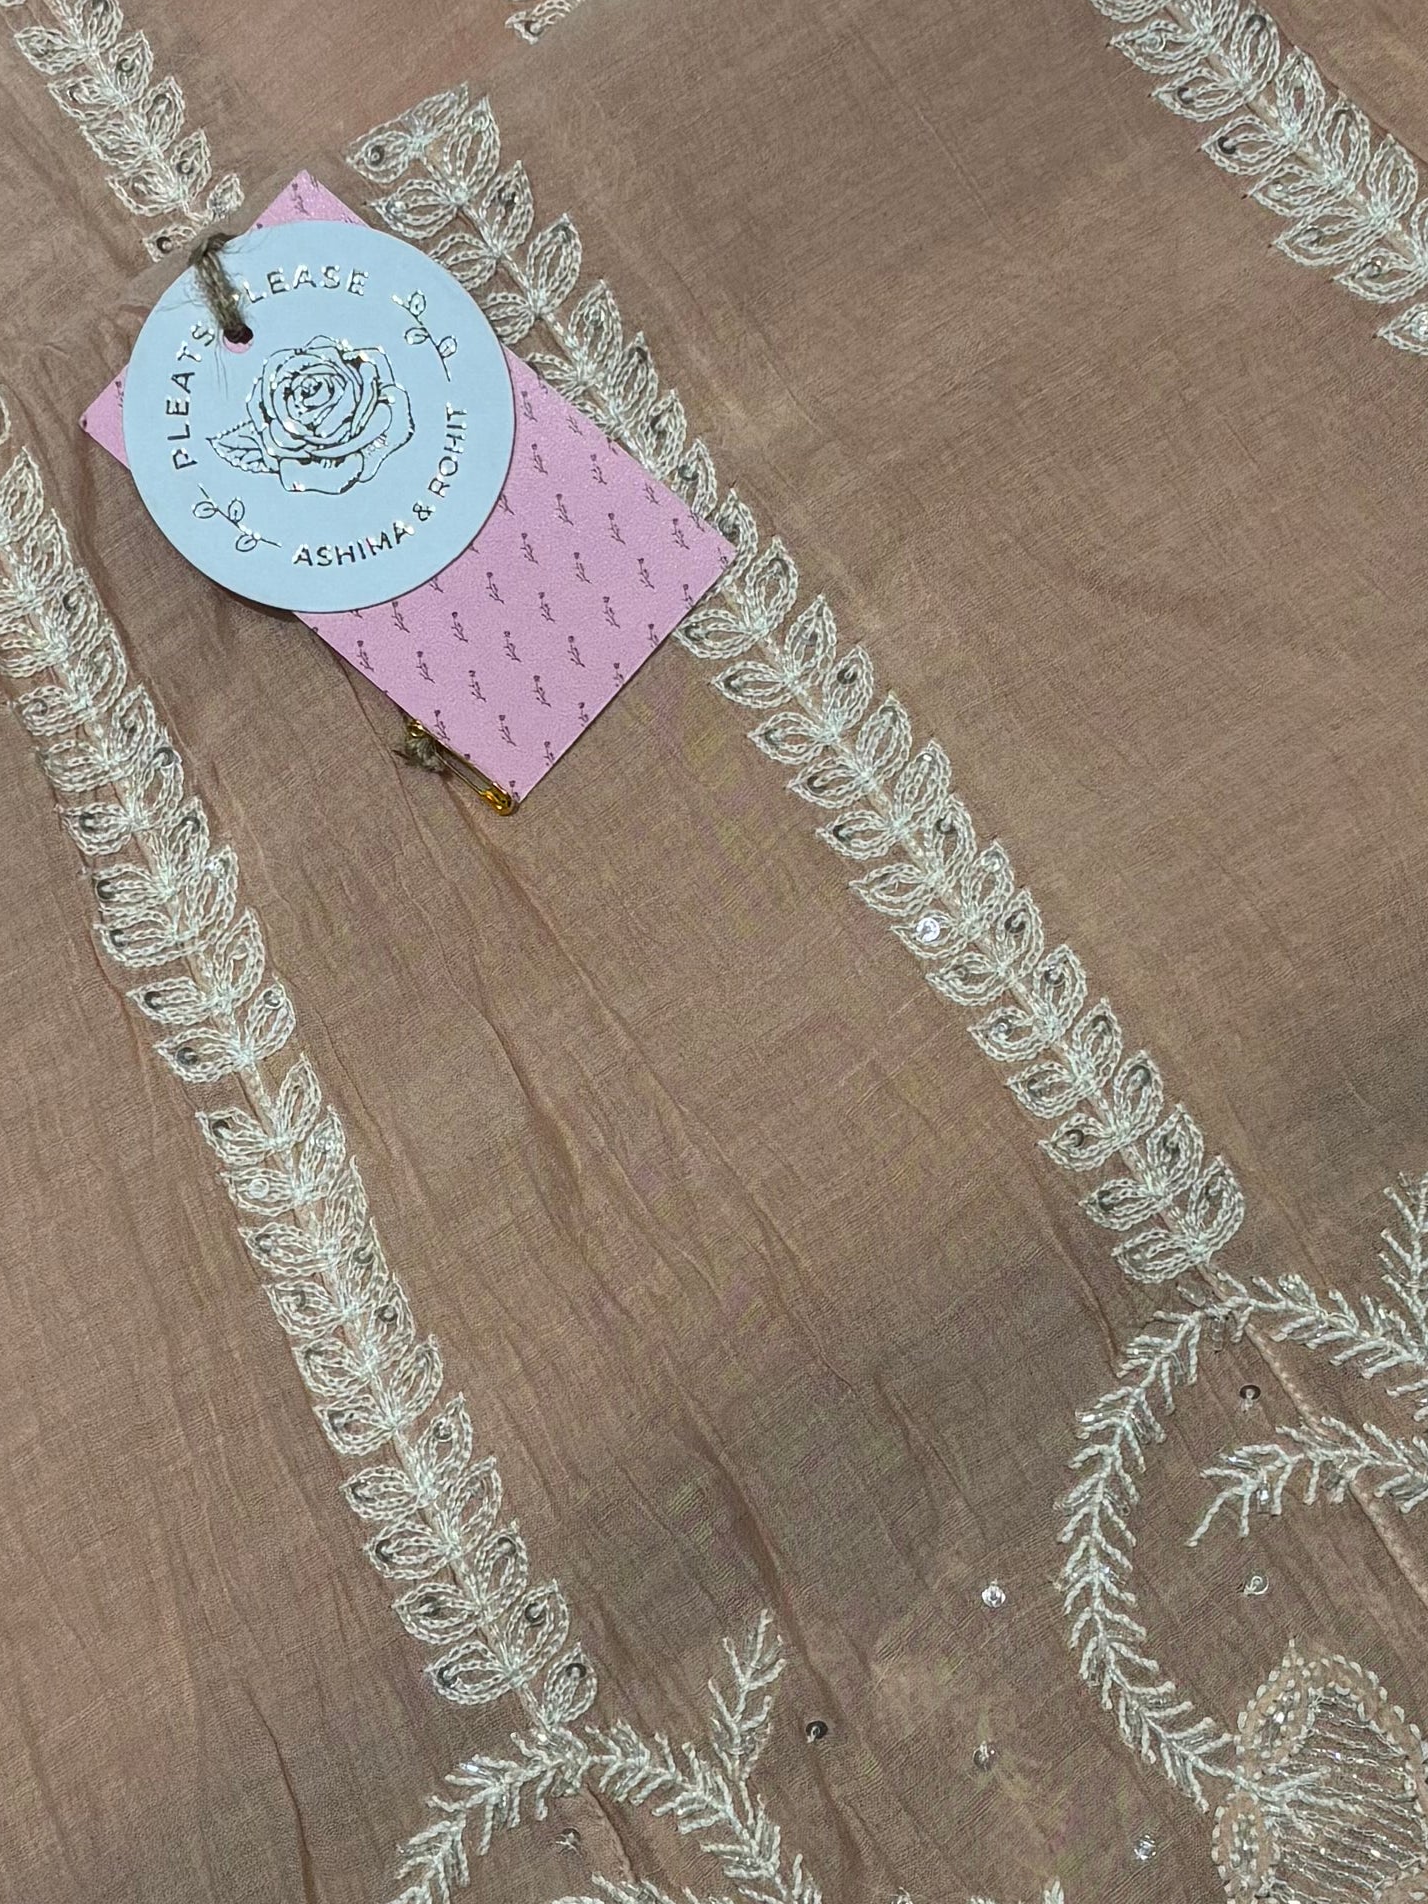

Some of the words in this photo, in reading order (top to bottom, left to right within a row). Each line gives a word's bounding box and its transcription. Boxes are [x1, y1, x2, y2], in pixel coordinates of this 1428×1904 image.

[165, 320, 216, 470] PLEATS
[232, 264, 370, 304] LEASE
[291, 519, 416, 567] ASHIMA
[412, 499, 437, 522] &
[427, 400, 468, 498] ROHIT
